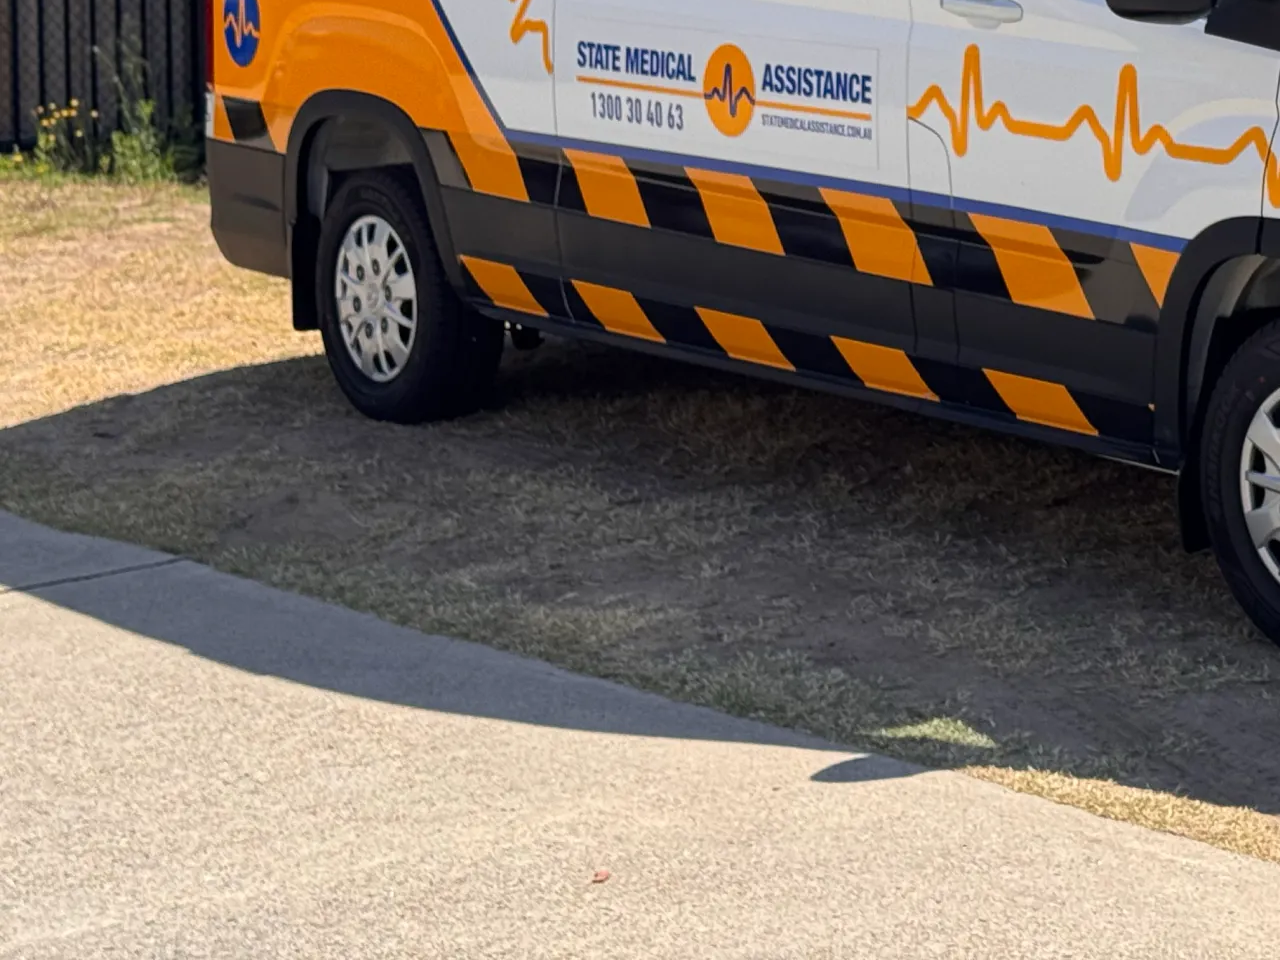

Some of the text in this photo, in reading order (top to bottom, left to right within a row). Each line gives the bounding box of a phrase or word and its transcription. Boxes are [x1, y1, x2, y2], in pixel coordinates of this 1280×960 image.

[577, 40, 872, 105] STATE MEDICAL ASSISTANCE
[591, 91, 684, 131] 1300 30 40 63
